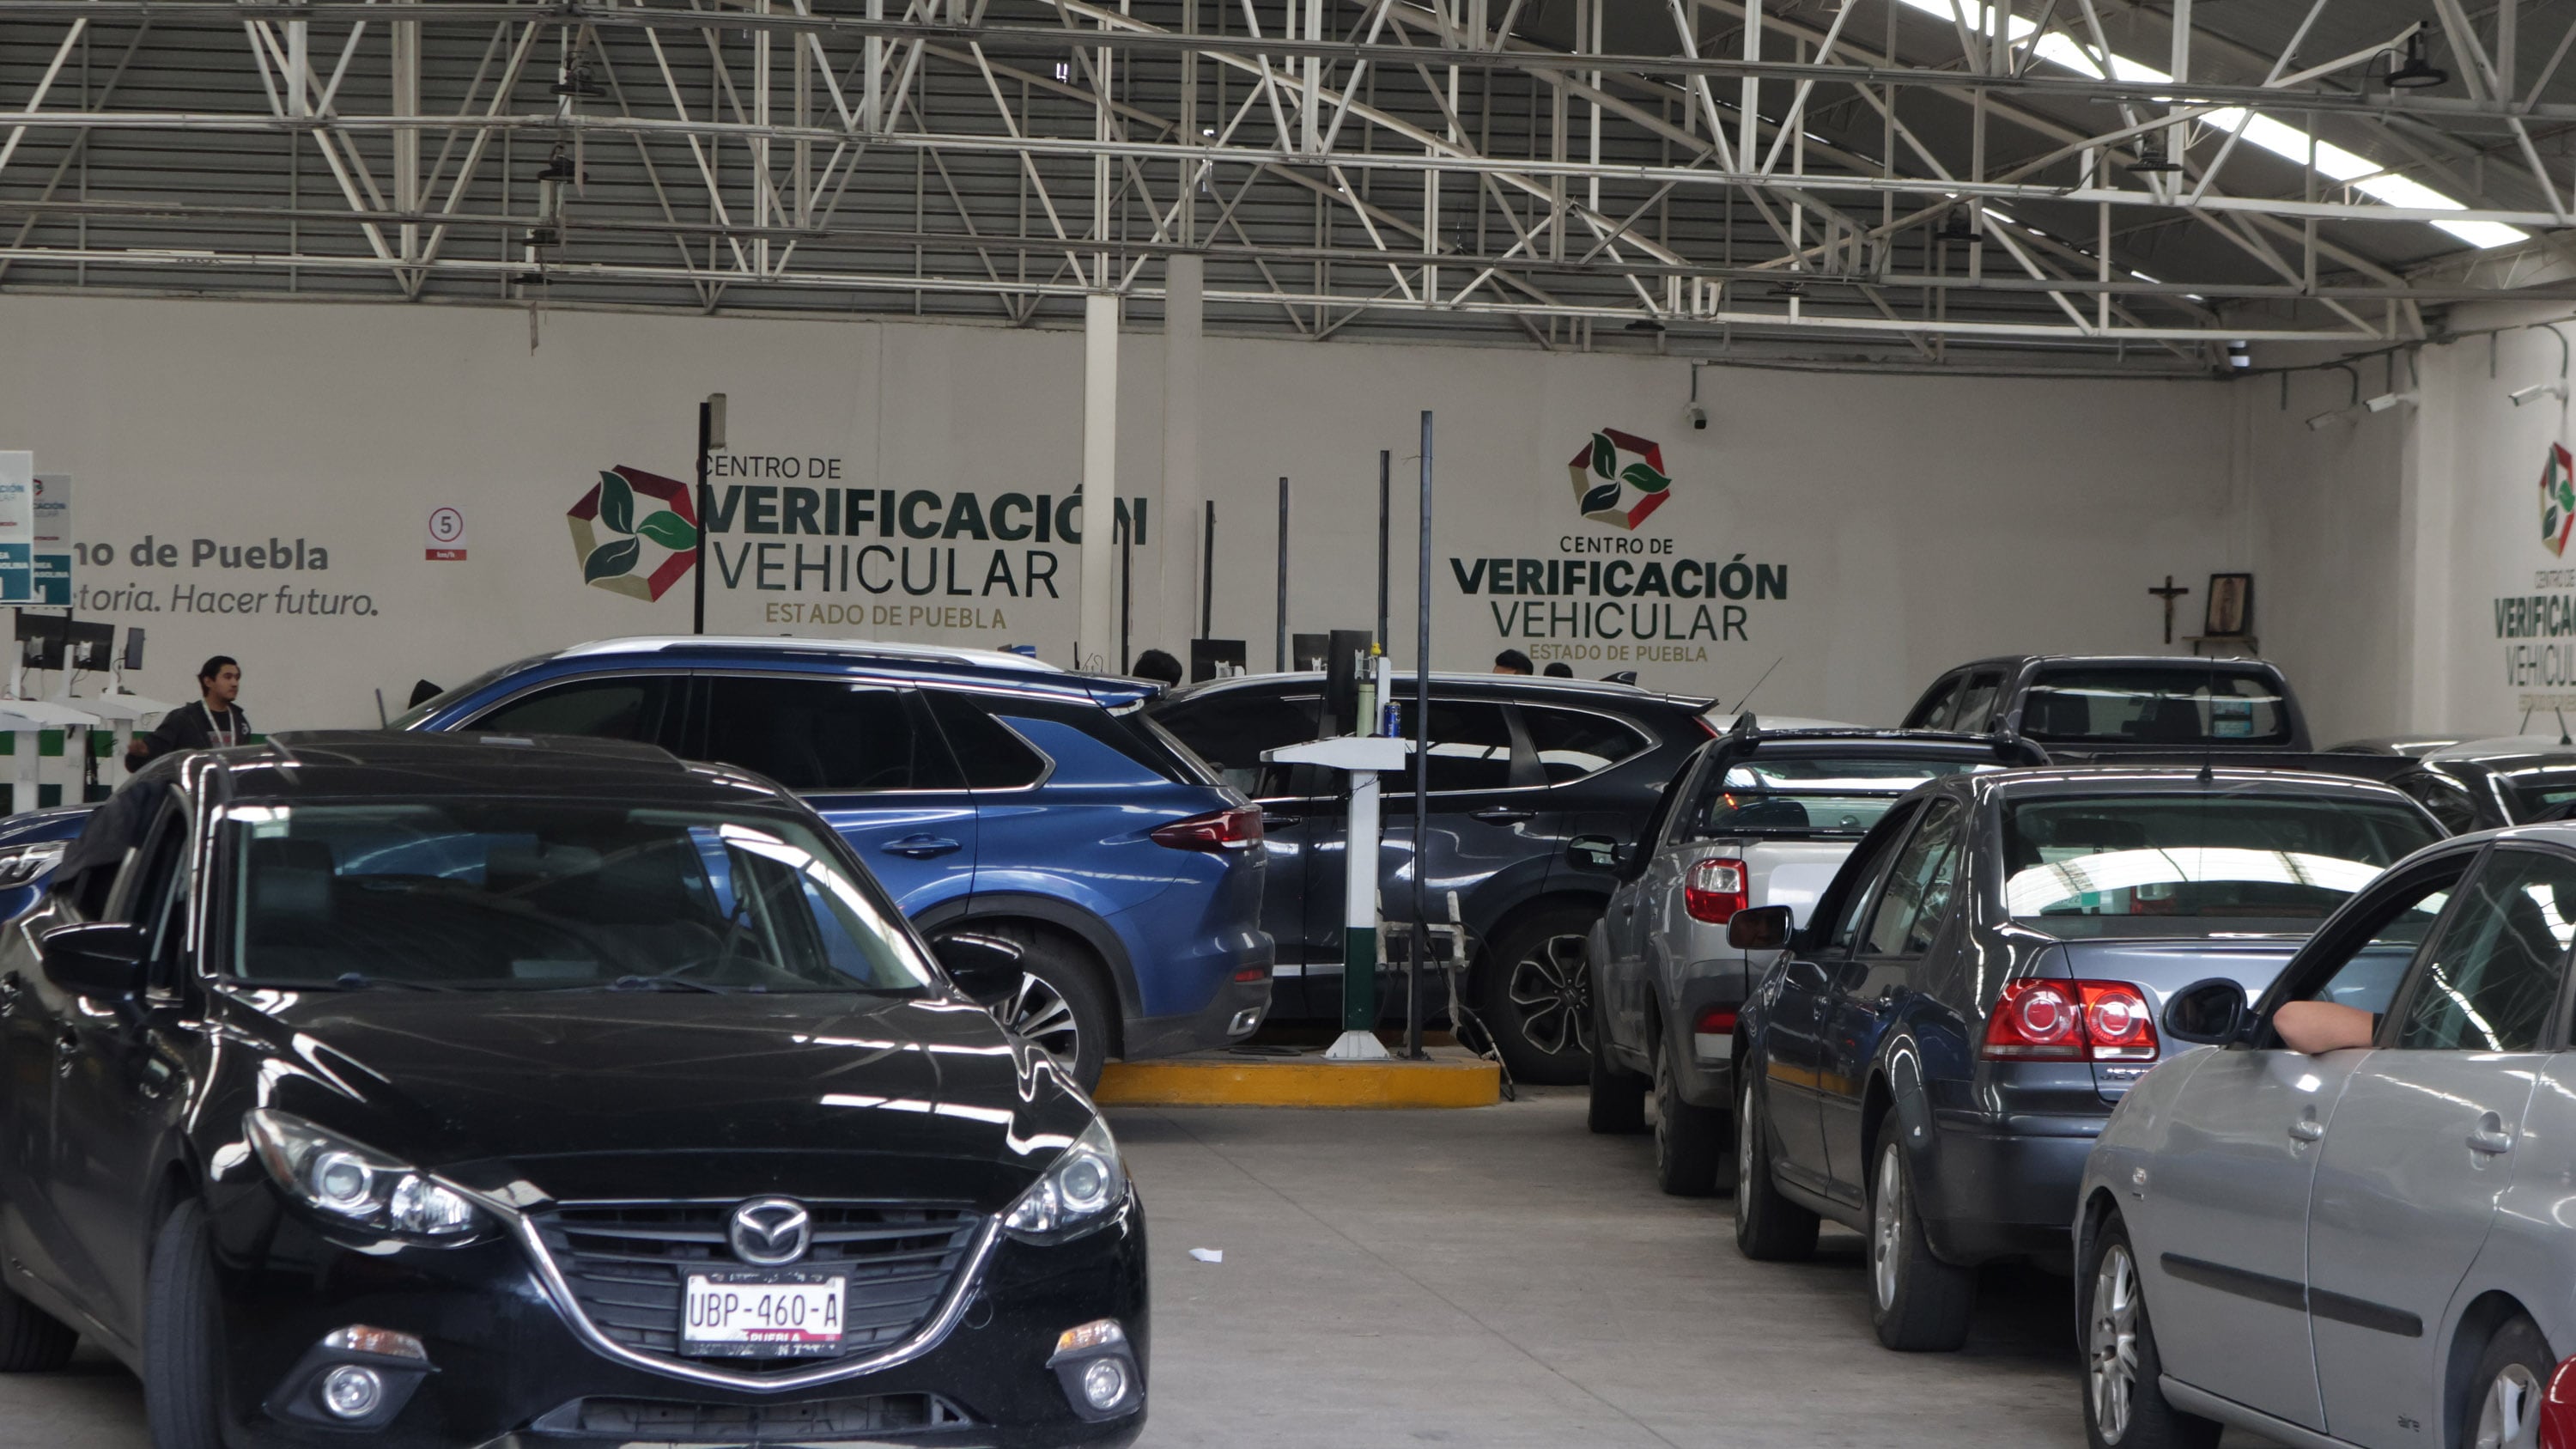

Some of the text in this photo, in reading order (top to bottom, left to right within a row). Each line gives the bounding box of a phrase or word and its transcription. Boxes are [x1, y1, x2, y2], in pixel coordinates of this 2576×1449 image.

[697, 455, 841, 478] CENTRO DE
[440, 515, 452, 534] 5
[697, 484, 1147, 545] VERIFICACIÓN
[130, 535, 179, 568] de
[191, 537, 329, 571] Puebla
[1560, 536, 1674, 554] CENTRO DE
[713, 541, 1060, 599] VEHICULAR
[1449, 553, 1788, 600] VERIFICACIÓN
[72, 582, 379, 618] toria. Hacer futuro.
[765, 602, 1006, 630] ESTADO DE PUEBLA
[2494, 594, 2576, 639] VERIFICA
[1491, 600, 1748, 642] VEHICULAR
[1529, 643, 1708, 662] ESTADO DE PUEBLA
[690, 1293, 838, 1328] UBP-460-A
